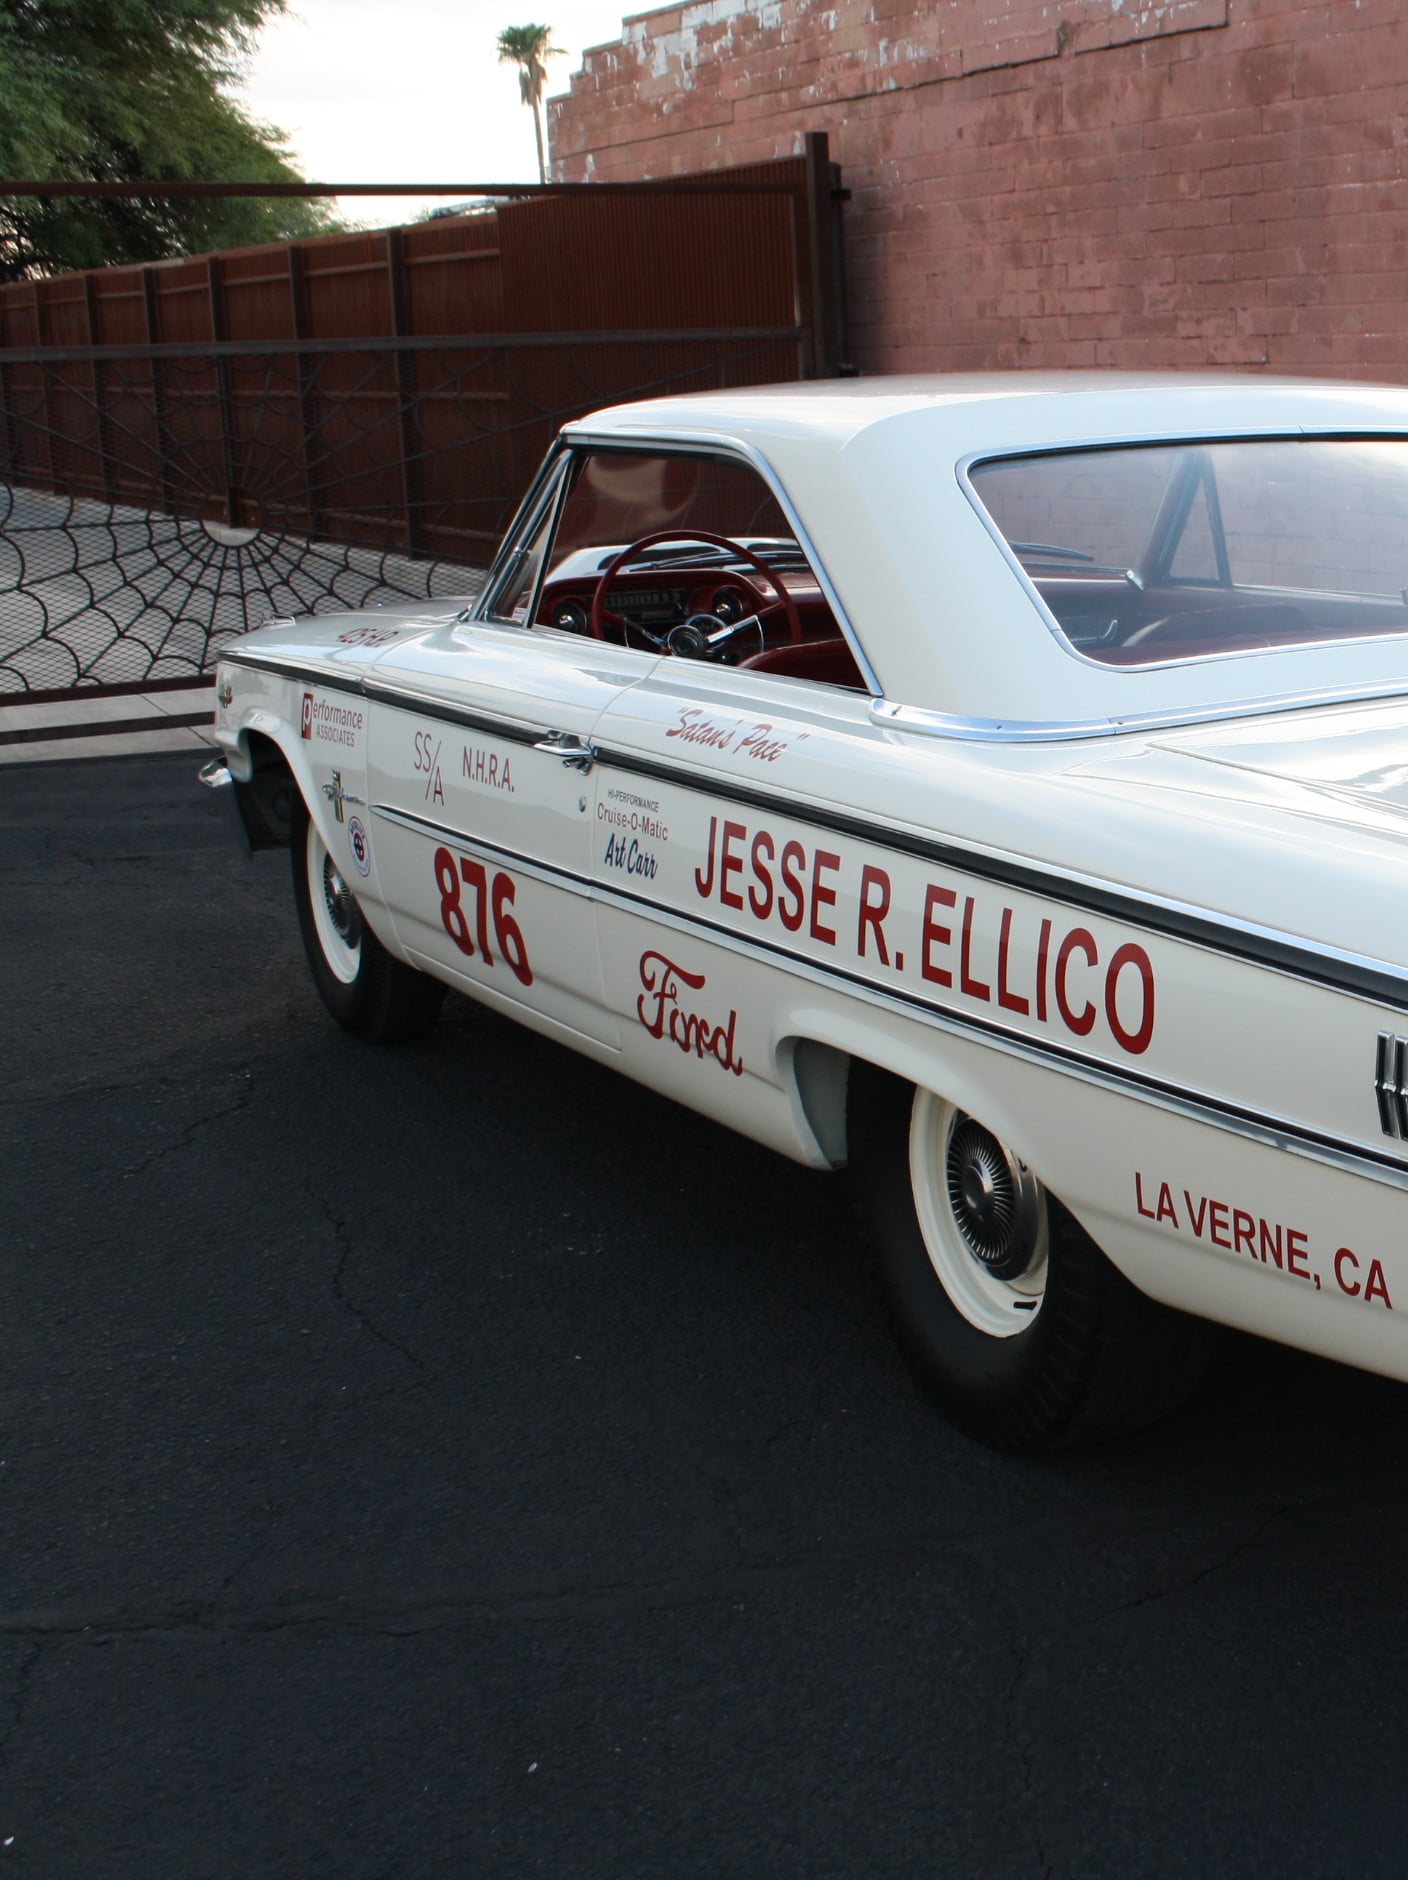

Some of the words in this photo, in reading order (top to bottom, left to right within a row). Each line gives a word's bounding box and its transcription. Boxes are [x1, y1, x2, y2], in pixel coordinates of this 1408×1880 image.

[316, 724, 355, 747] ASSOCIATES
[463, 745, 514, 793] N.H.R.A.
[597, 802, 668, 841] Cruise-O-Matic
[608, 788, 659, 813] HI-PERFORMANCE
[604, 832, 627, 869] Art
[627, 838, 659, 879] Carr
[434, 847, 533, 987] 876
[695, 816, 841, 946] JESSE
[857, 864, 904, 972] R.
[922, 883, 1155, 1055] ELLICO
[637, 950, 743, 1077] Ford
[1135, 1172, 1179, 1229] LA
[1183, 1190, 1321, 1291] VERNE,
[1334, 1248, 1393, 1310] CA
